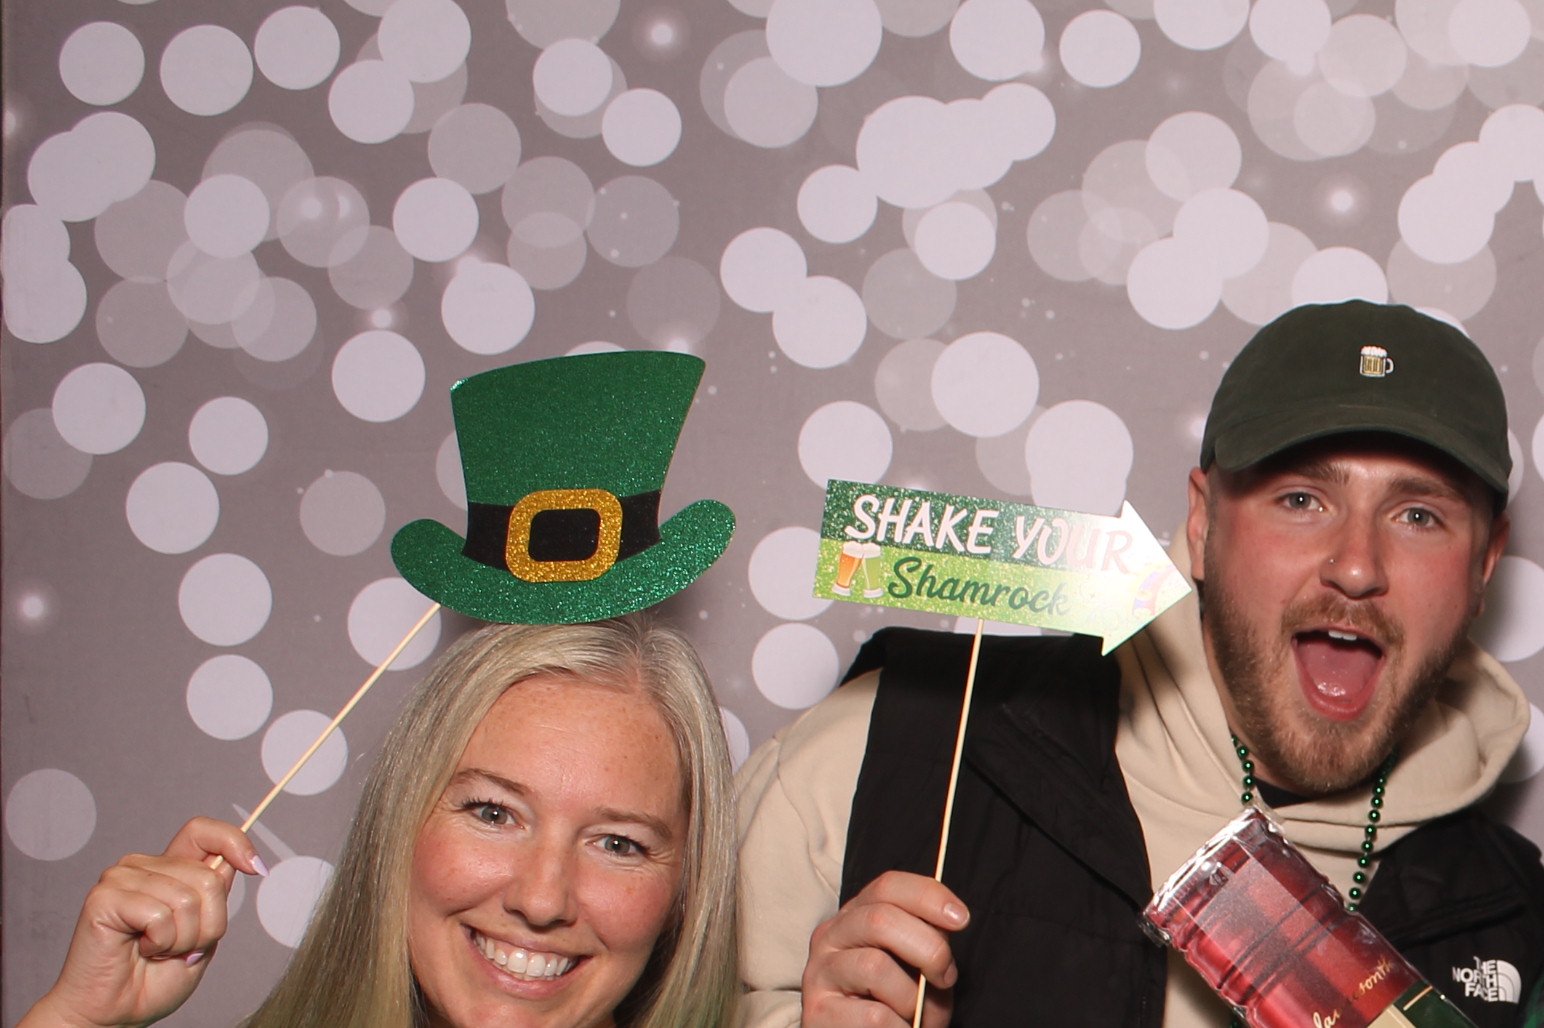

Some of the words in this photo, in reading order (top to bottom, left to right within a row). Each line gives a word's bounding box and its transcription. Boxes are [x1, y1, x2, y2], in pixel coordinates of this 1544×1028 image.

[845, 494, 999, 554] SHAKE
[1013, 515, 1133, 575] YOUR
[888, 556, 1070, 616] Shamrock
